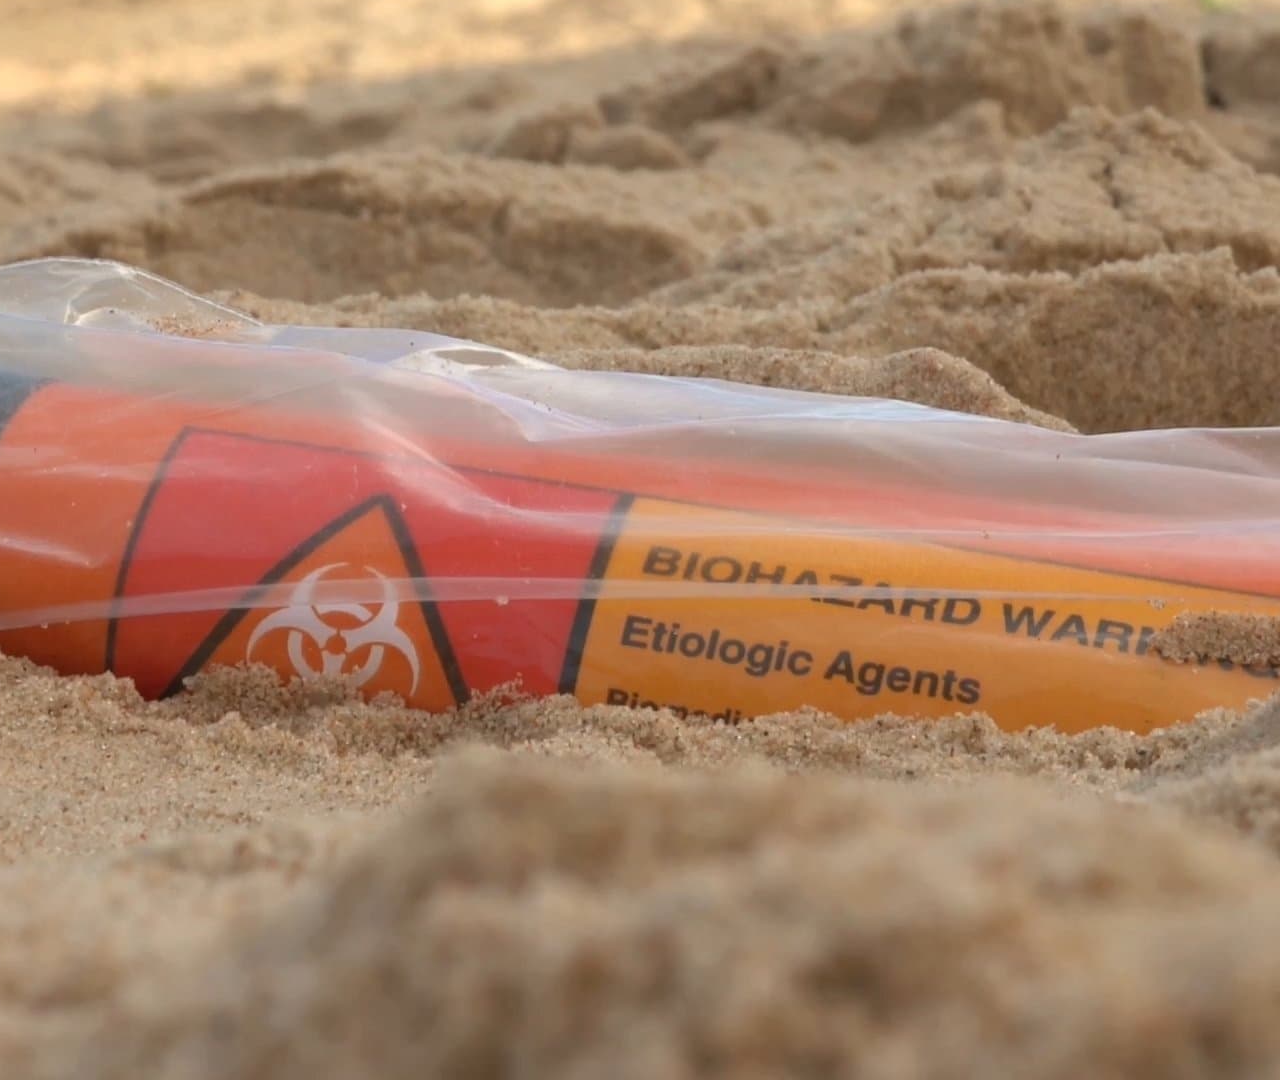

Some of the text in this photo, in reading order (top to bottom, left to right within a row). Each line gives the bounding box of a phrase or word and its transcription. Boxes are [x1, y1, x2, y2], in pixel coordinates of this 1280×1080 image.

[641, 545, 982, 625] BIOHAZARD
[621, 614, 981, 705] Etiologic Agents
